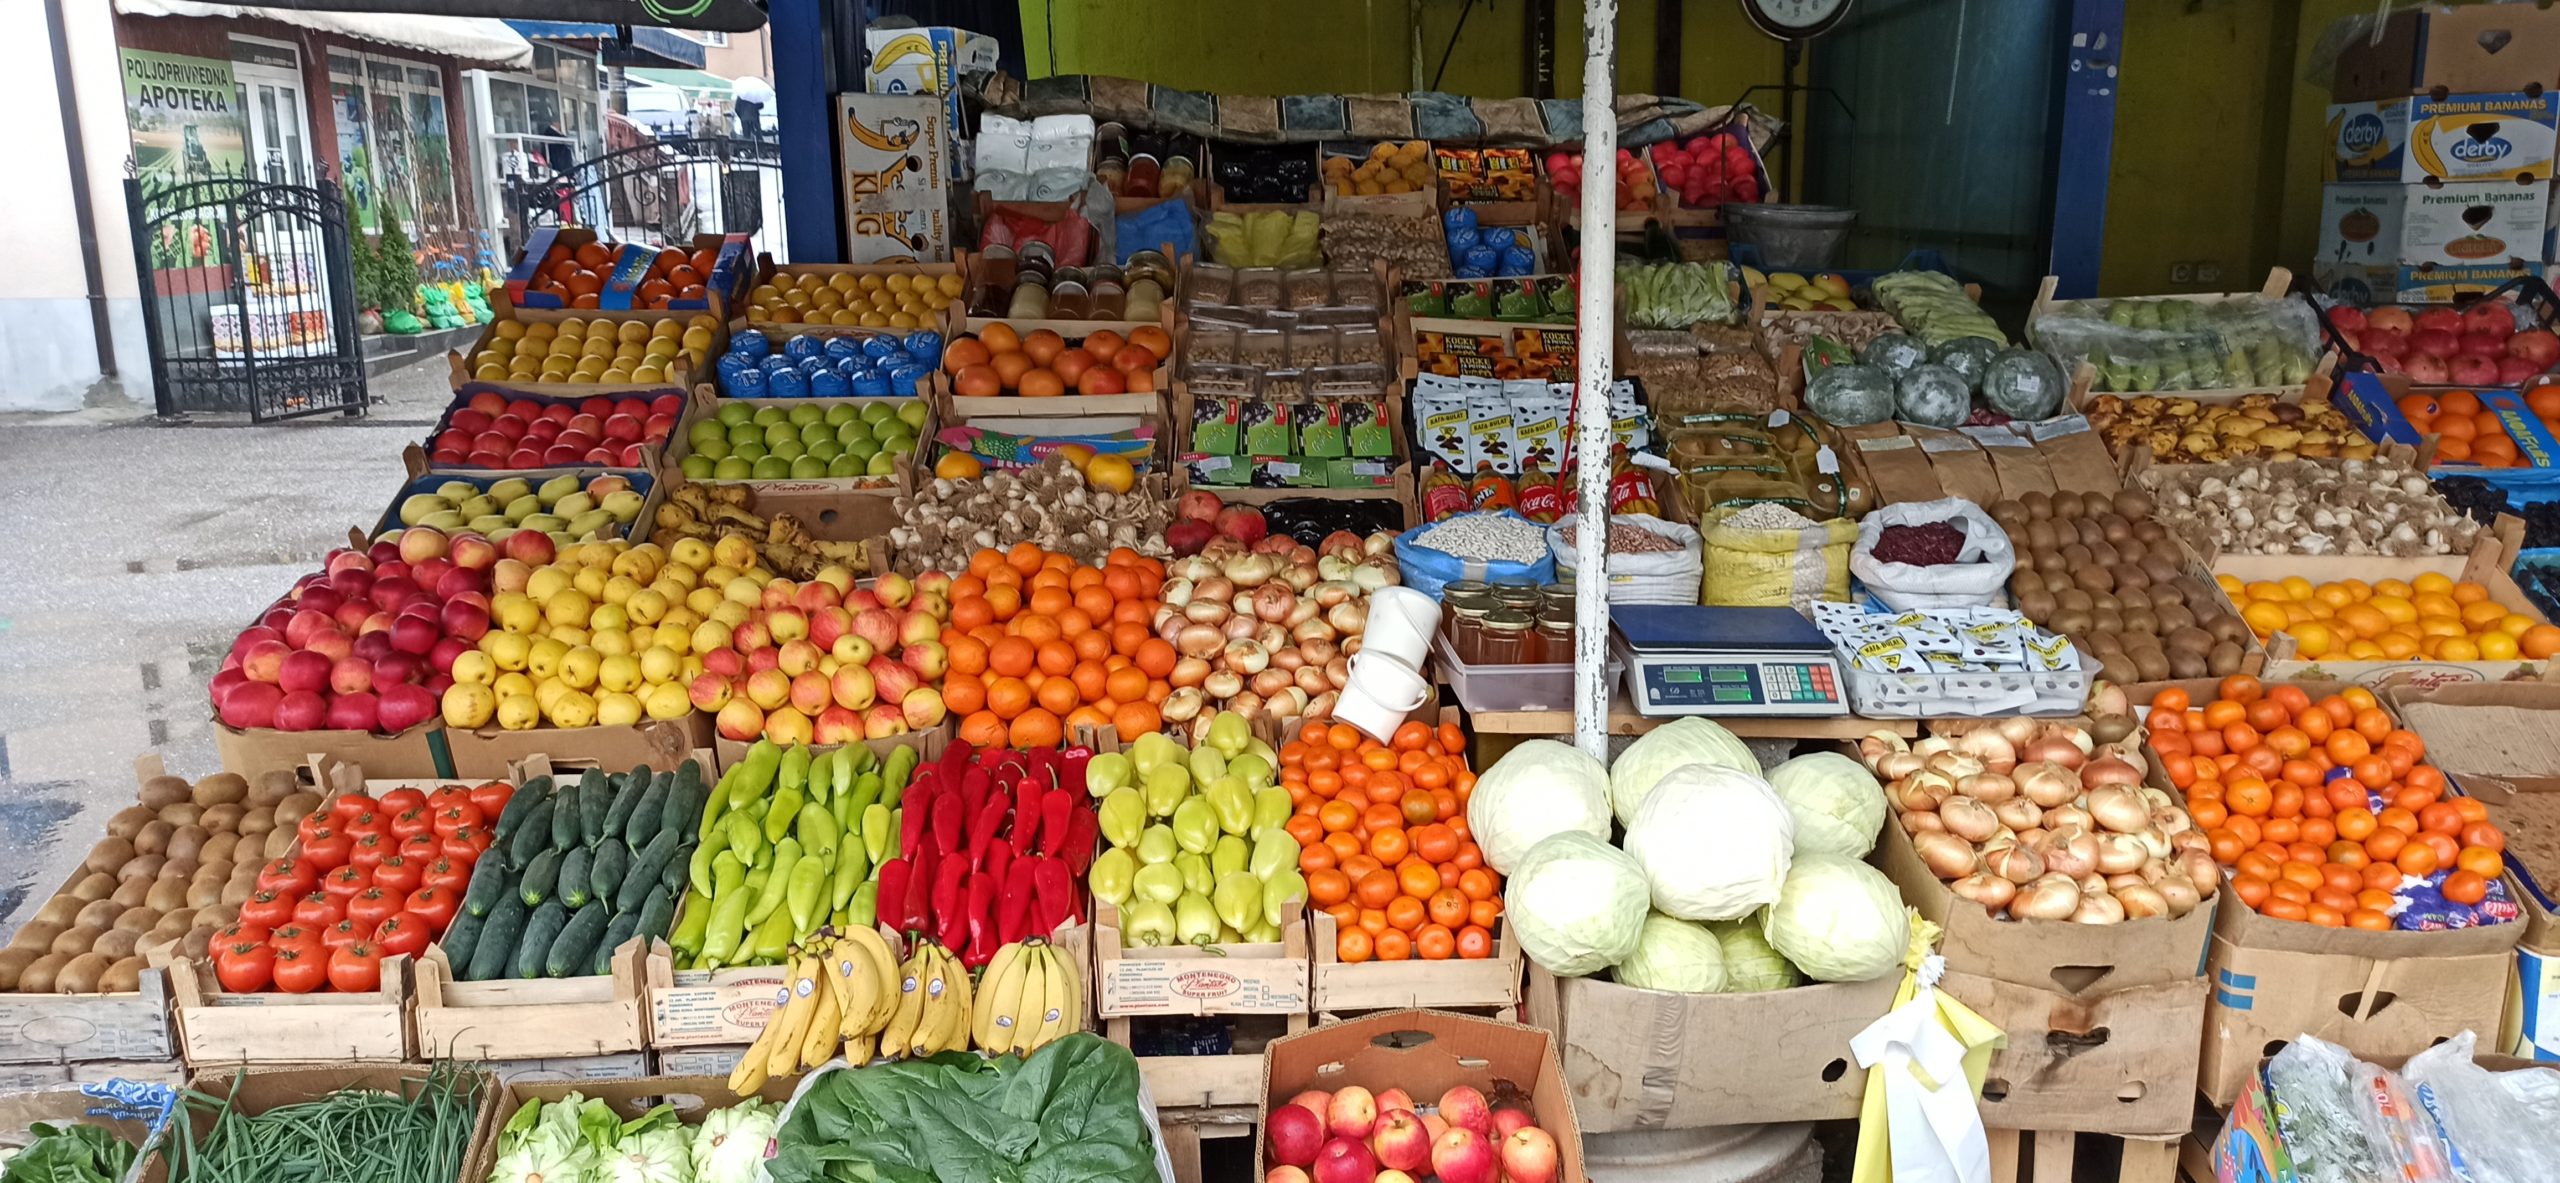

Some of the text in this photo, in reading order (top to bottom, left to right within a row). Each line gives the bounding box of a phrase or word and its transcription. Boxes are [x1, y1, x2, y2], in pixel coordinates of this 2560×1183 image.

[126, 58, 229, 87] POLJOPRIVREDNA
[140, 84, 228, 112] APOTEKA
[2420, 99, 2547, 114] PREMIUM BANANAS
[2345, 117, 2381, 149] derby
[2454, 139, 2508, 159] derby
[925, 116, 937, 149] Super
[931, 208, 944, 242] uality
[852, 171, 883, 237] KIG
[2422, 192, 2535, 205] Premium Bananas
[2411, 269, 2532, 281] PREMIUM BANANAS
[1176, 971, 1236, 984] MONTENEGRO
[1182, 989, 1206, 997] SUPER
